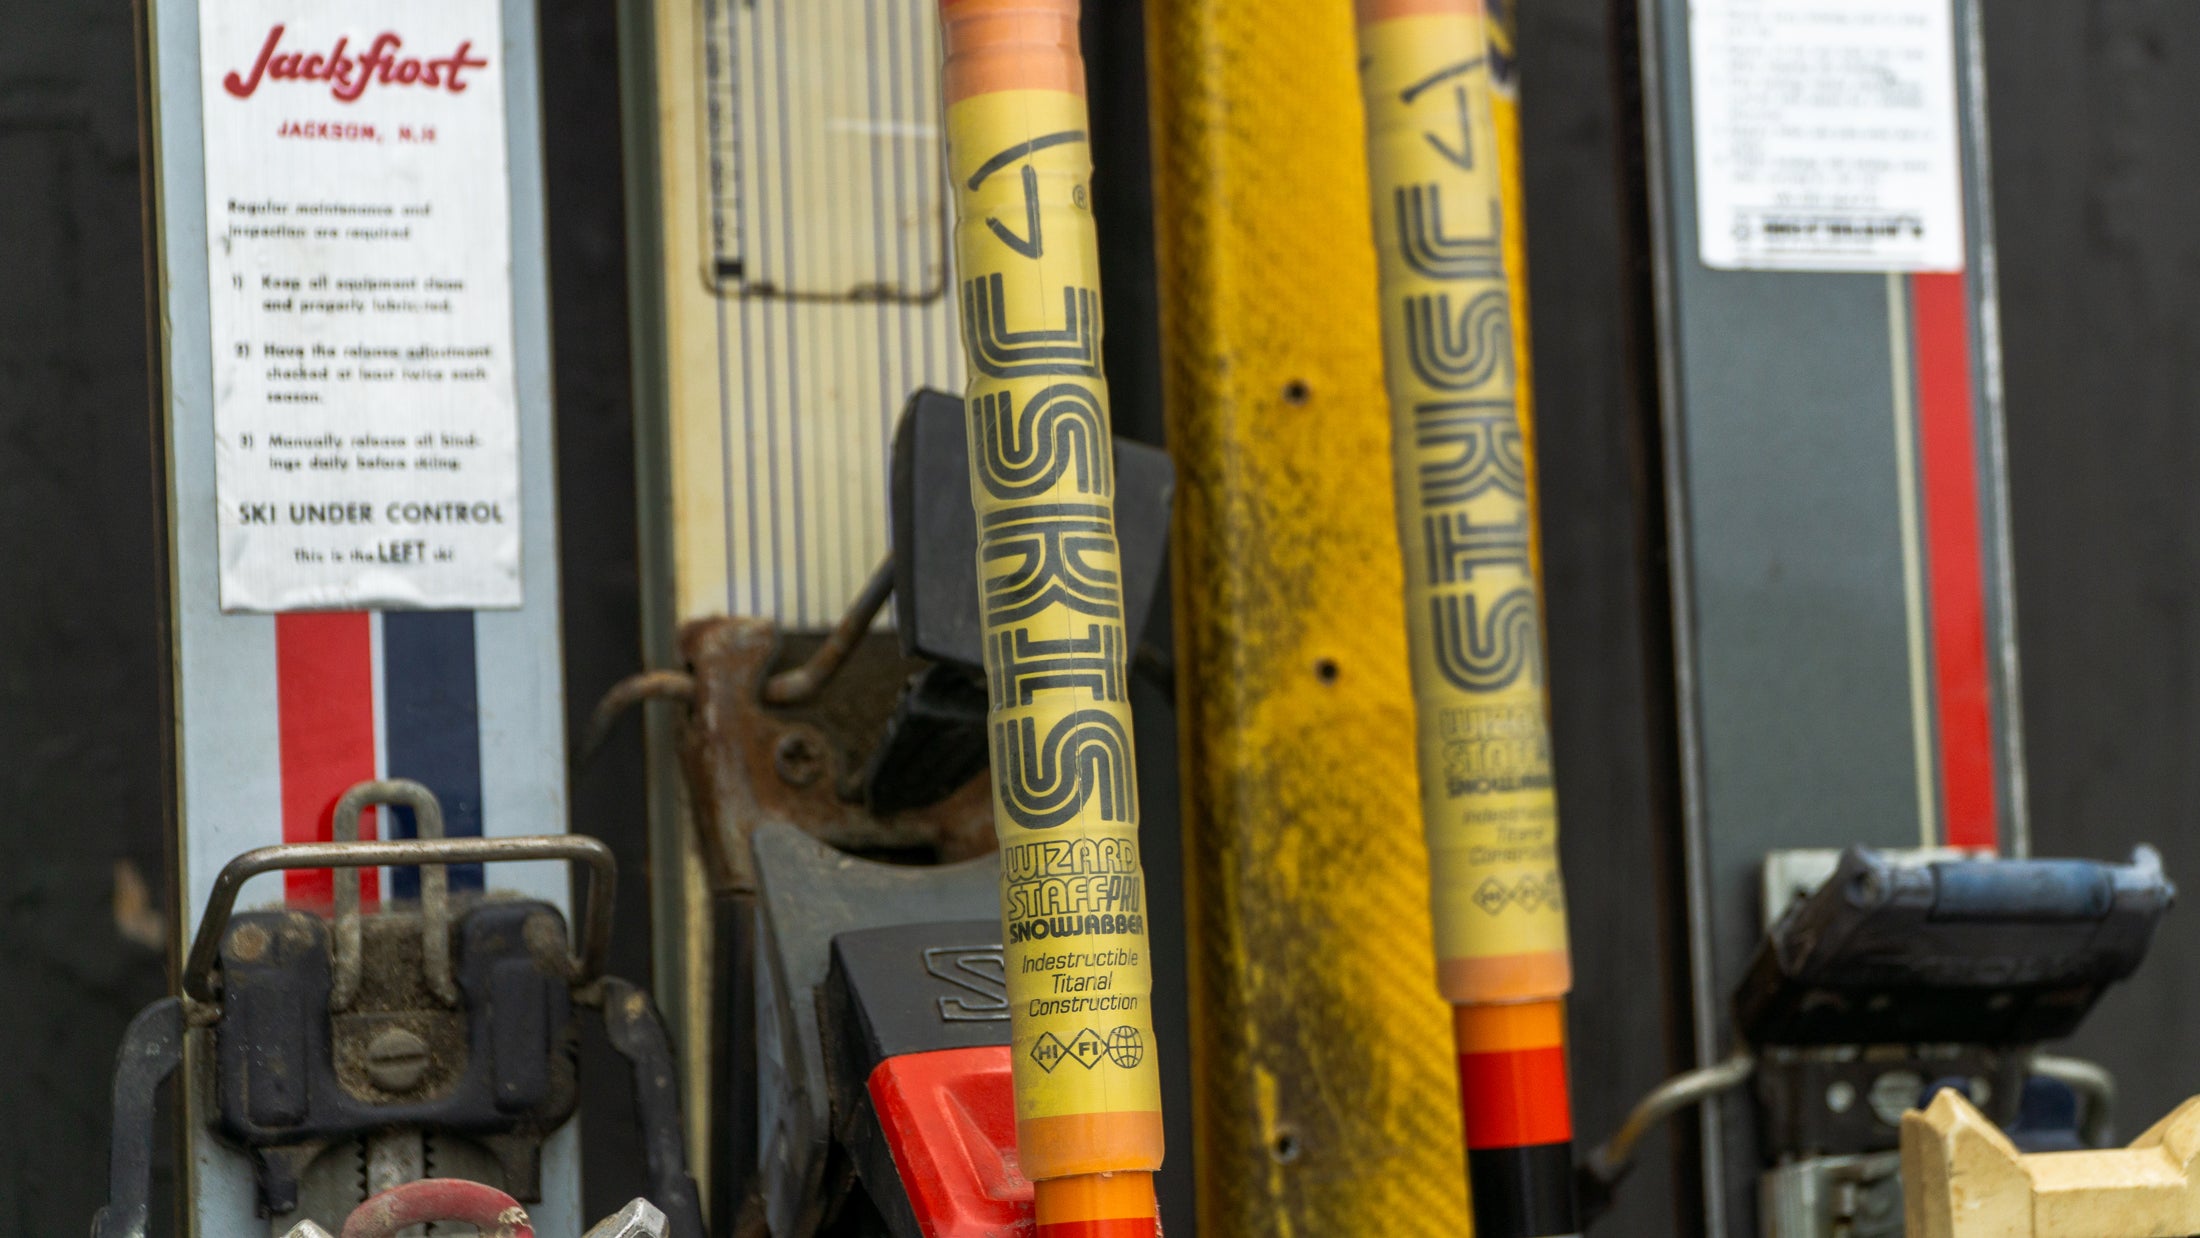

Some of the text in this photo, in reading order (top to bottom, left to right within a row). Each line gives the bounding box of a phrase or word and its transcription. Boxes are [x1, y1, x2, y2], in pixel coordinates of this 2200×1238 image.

[228, 197, 432, 216] Regular maintenance and
[228, 221, 307, 240] inspection
[314, 226, 339, 239] are
[261, 273, 301, 291] Keep
[309, 274, 328, 290] all
[335, 276, 417, 292] equipment
[423, 276, 465, 291] clean
[262, 297, 293, 312] and
[300, 300, 366, 314] properly
[264, 341, 305, 358] Have
[311, 341, 337, 357] the
[343, 343, 400, 358] release
[266, 365, 488, 381] checked at least twice each
[268, 431, 343, 449] Manually
[351, 433, 408, 448] release
[415, 433, 434, 447] all
[309, 454, 350, 471] daily
[357, 456, 408, 470] before
[239, 503, 504, 524] SKI UNDER CONTROL
[295, 548, 323, 563] this
[351, 549, 373, 562] the
[378, 540, 426, 563] LEFT
[1005, 836, 1138, 884] WIZARD
[1007, 876, 1109, 922] STAFF
[1009, 914, 1144, 945] SNOWJABBER
[1022, 948, 1138, 974] Indestructible
[1052, 971, 1112, 994] Titanal
[1029, 994, 1137, 1017] Construction
[1038, 1040, 1099, 1061] HI FI
